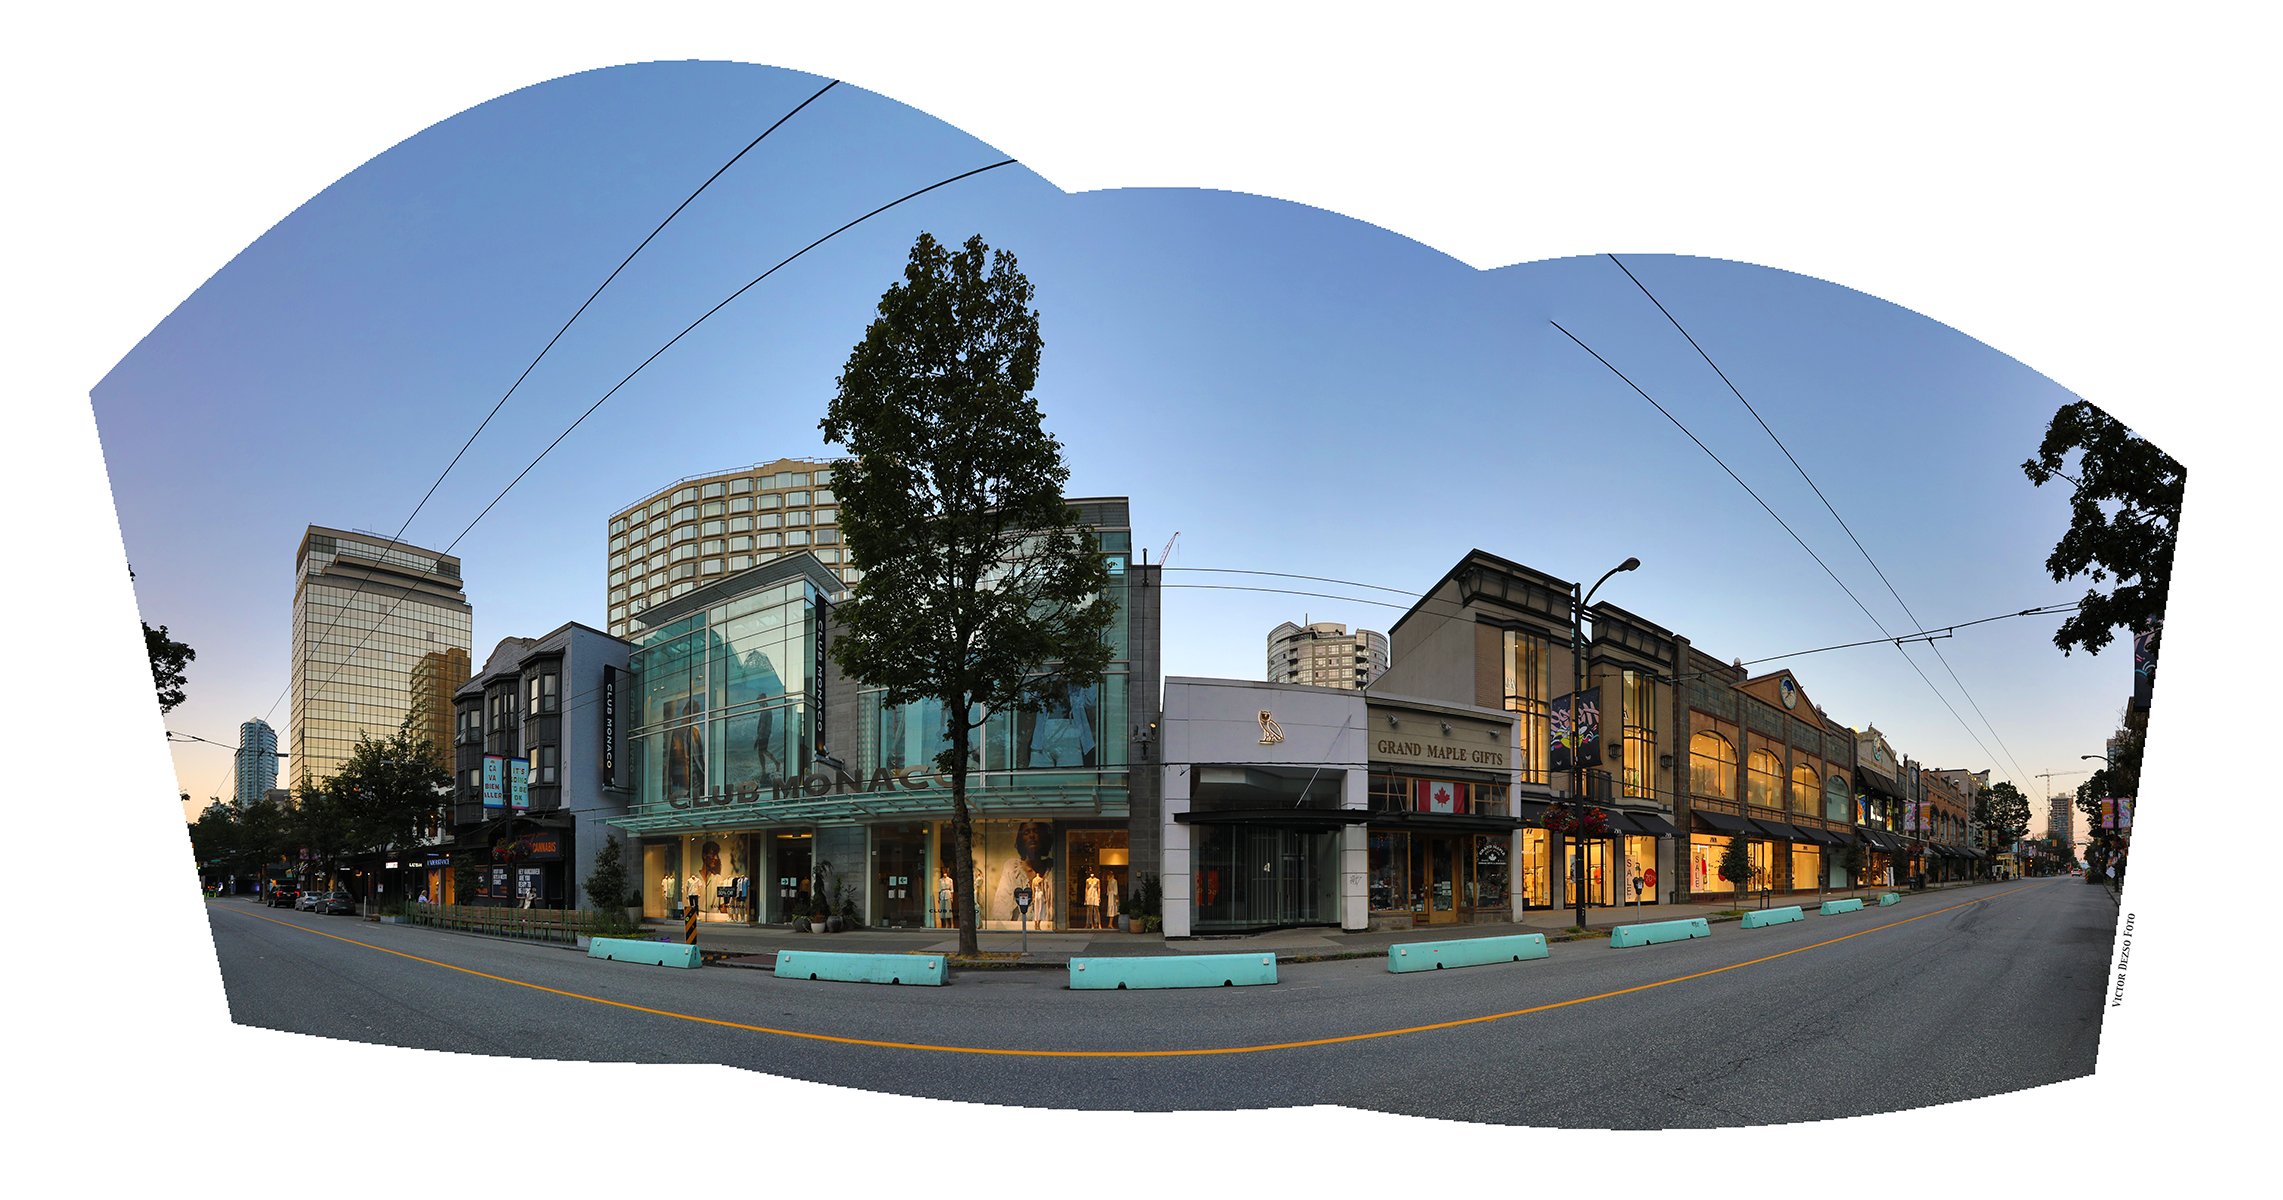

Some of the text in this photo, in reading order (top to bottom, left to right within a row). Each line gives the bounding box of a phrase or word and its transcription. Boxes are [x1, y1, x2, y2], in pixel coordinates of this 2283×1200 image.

[1377, 740, 1503, 766] GRAND MAPLE GIFTS
[669, 781, 760, 810] CLUB
